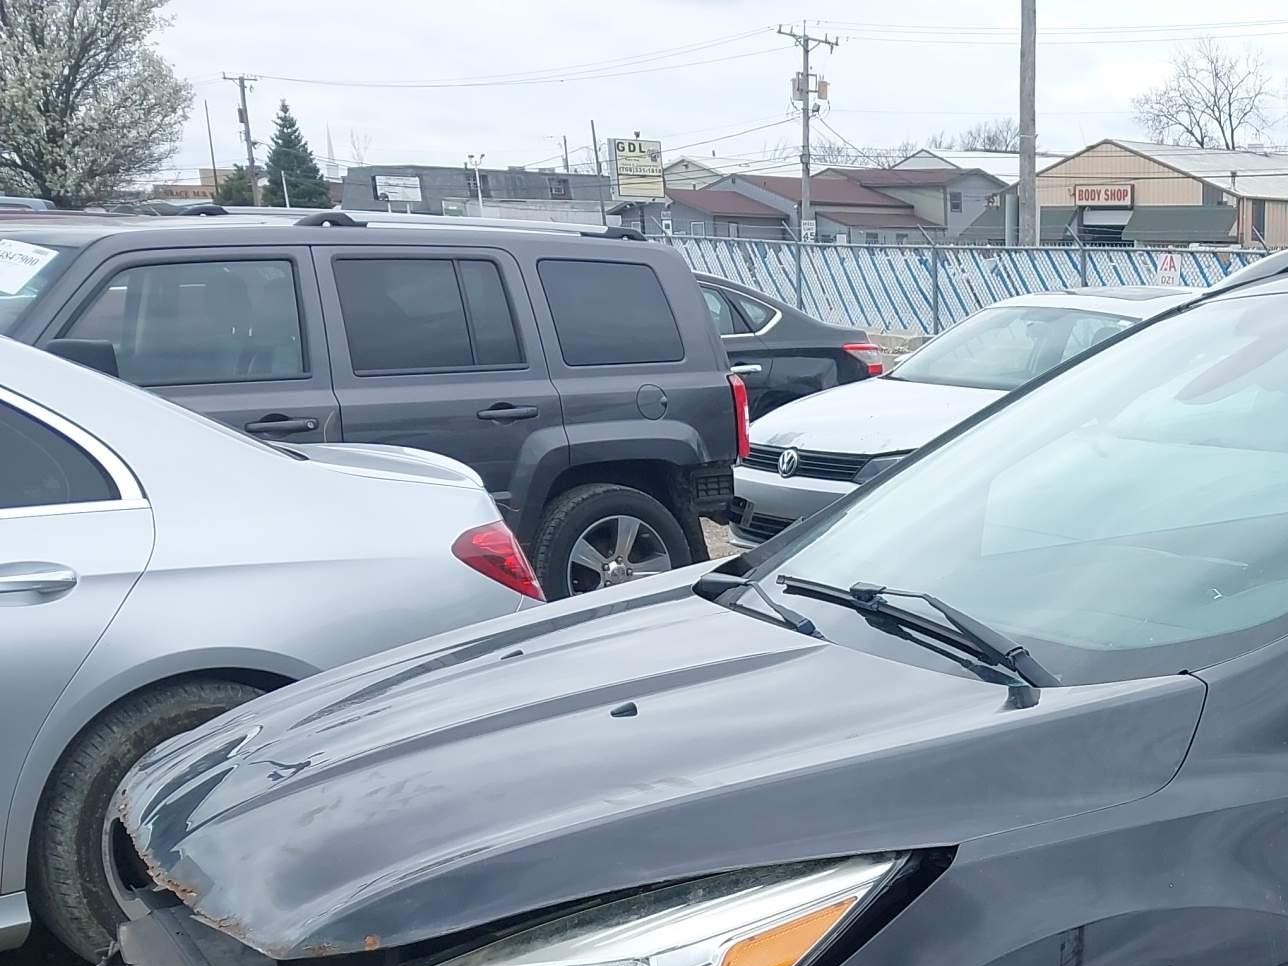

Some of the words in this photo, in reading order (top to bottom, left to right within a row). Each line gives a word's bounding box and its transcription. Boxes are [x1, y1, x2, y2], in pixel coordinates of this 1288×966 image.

[1078, 188, 1101, 202] BODY
[1104, 188, 1129, 202] SHOP
[803, 231, 815, 241] 45
